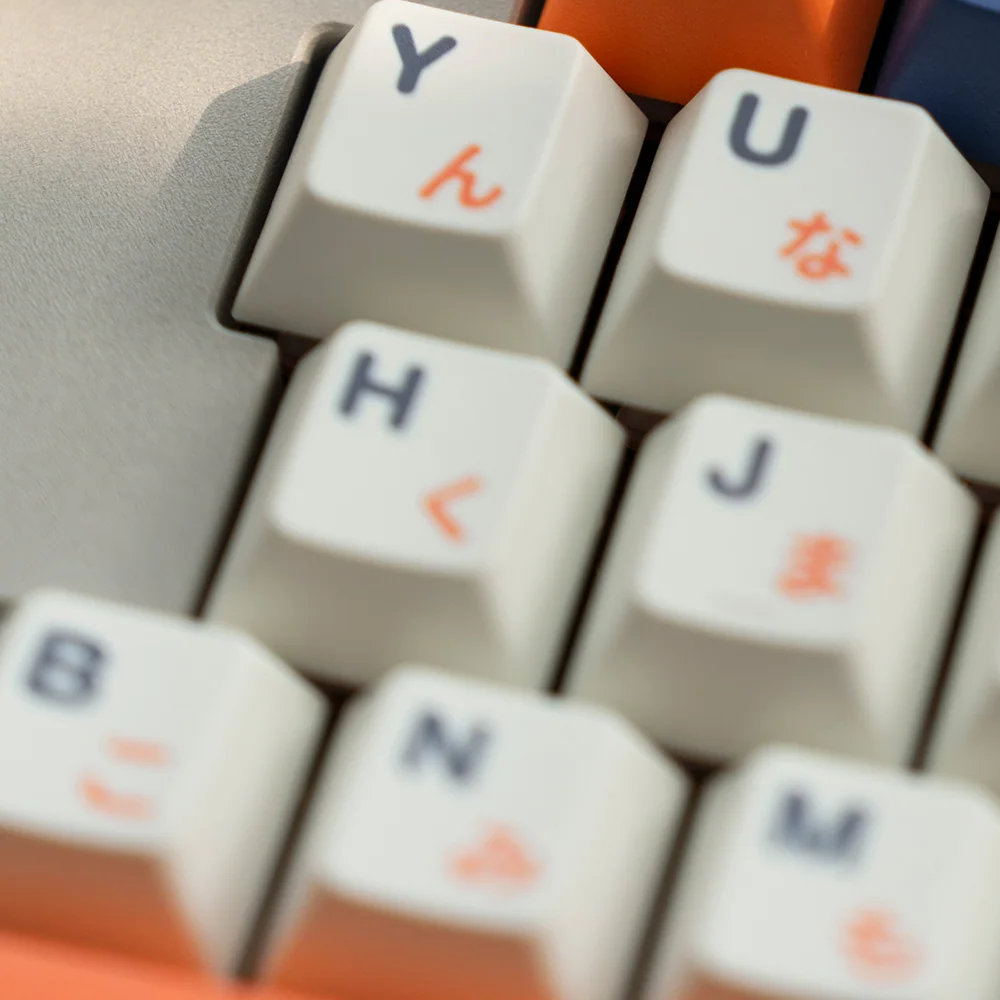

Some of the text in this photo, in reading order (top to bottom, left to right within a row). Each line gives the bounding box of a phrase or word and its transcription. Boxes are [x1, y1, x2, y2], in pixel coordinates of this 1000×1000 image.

[391, 23, 457, 95] Y
[729, 92, 808, 167] U
[418, 143, 503, 210] ん
[779, 212, 863, 281] な
[337, 352, 425, 430] H
[706, 436, 775, 502] J
[422, 476, 481, 543] く
[25, 626, 108, 707] B
[402, 710, 490, 786] N
[771, 790, 869, 867] M
